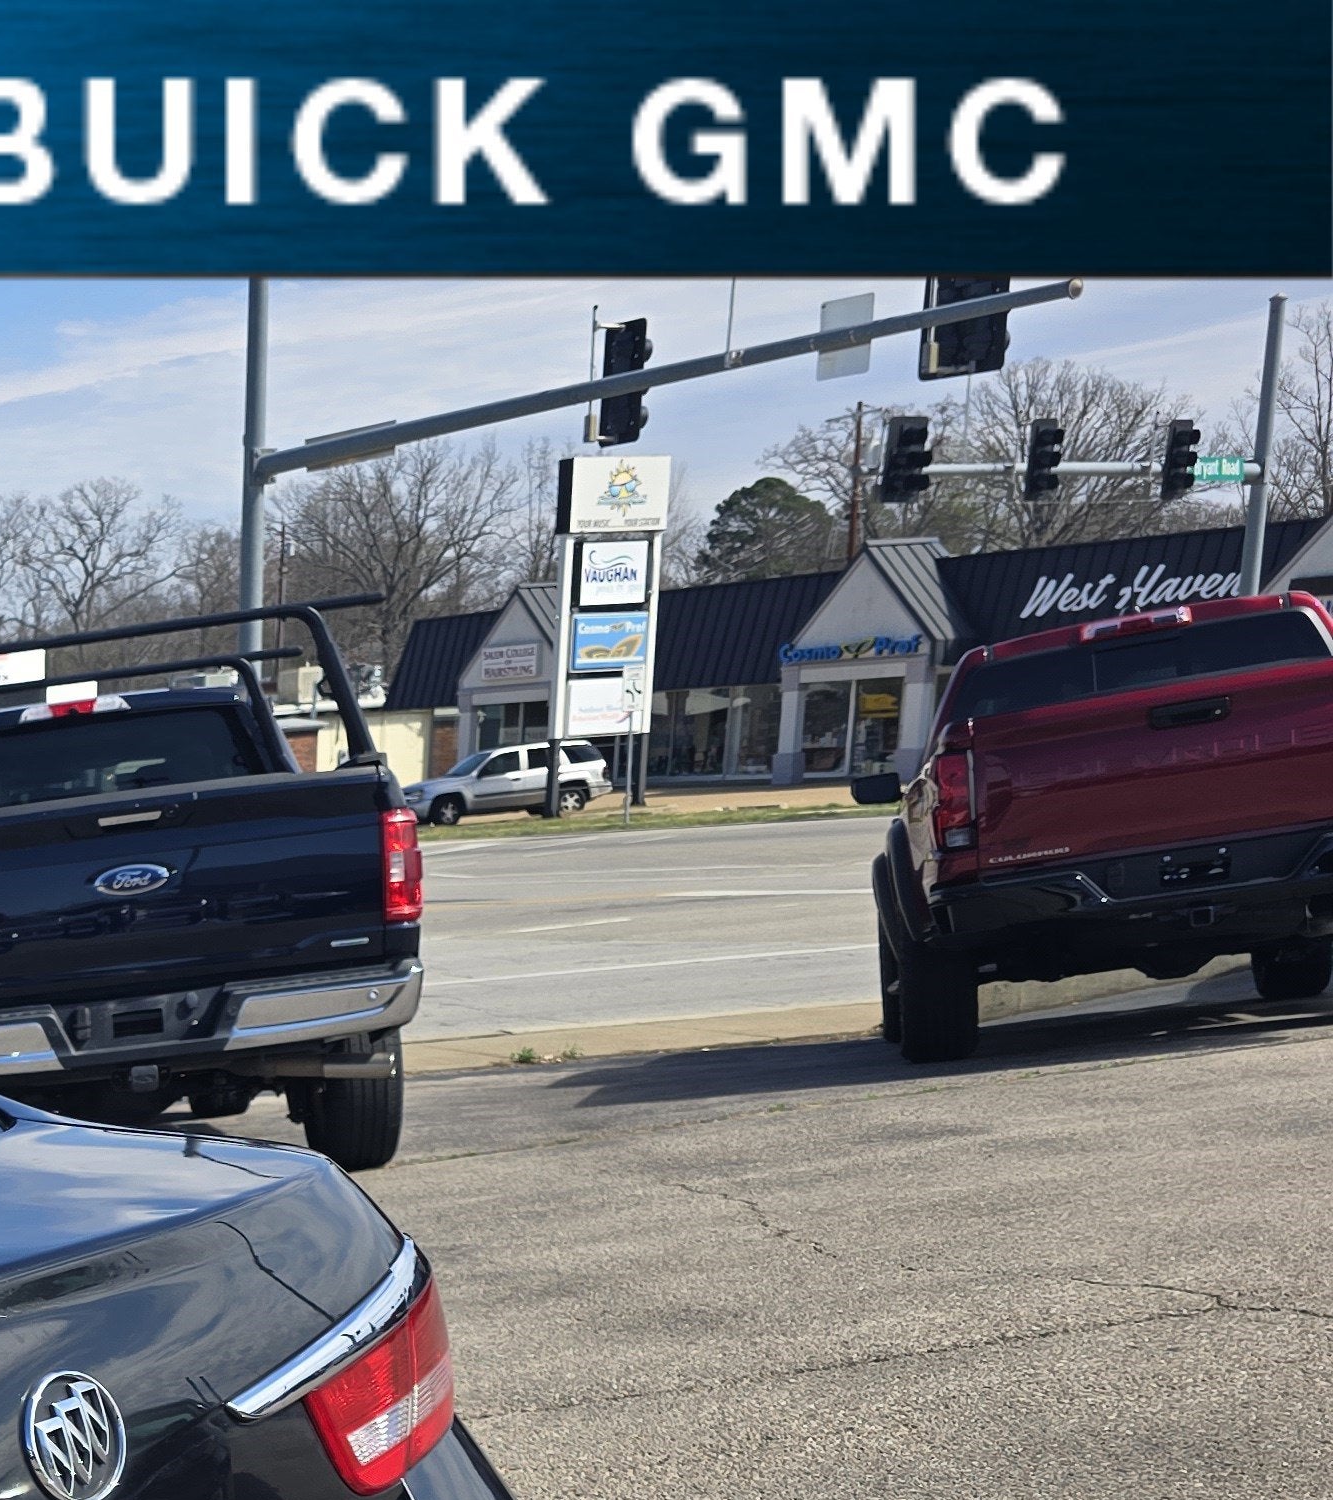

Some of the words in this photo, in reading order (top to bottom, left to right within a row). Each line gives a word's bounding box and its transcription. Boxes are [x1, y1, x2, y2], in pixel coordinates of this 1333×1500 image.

[1222, 458, 1240, 475] Road
[585, 568, 637, 583] VAUGHAN
[1019, 573, 1116, 618] West
[1114, 564, 1243, 608] Haven
[578, 622, 610, 634] Cosmo
[626, 620, 645, 633] Prof
[779, 643, 841, 665] Cosmo
[874, 634, 923, 656] Prof
[113, 870, 152, 889] Ford
